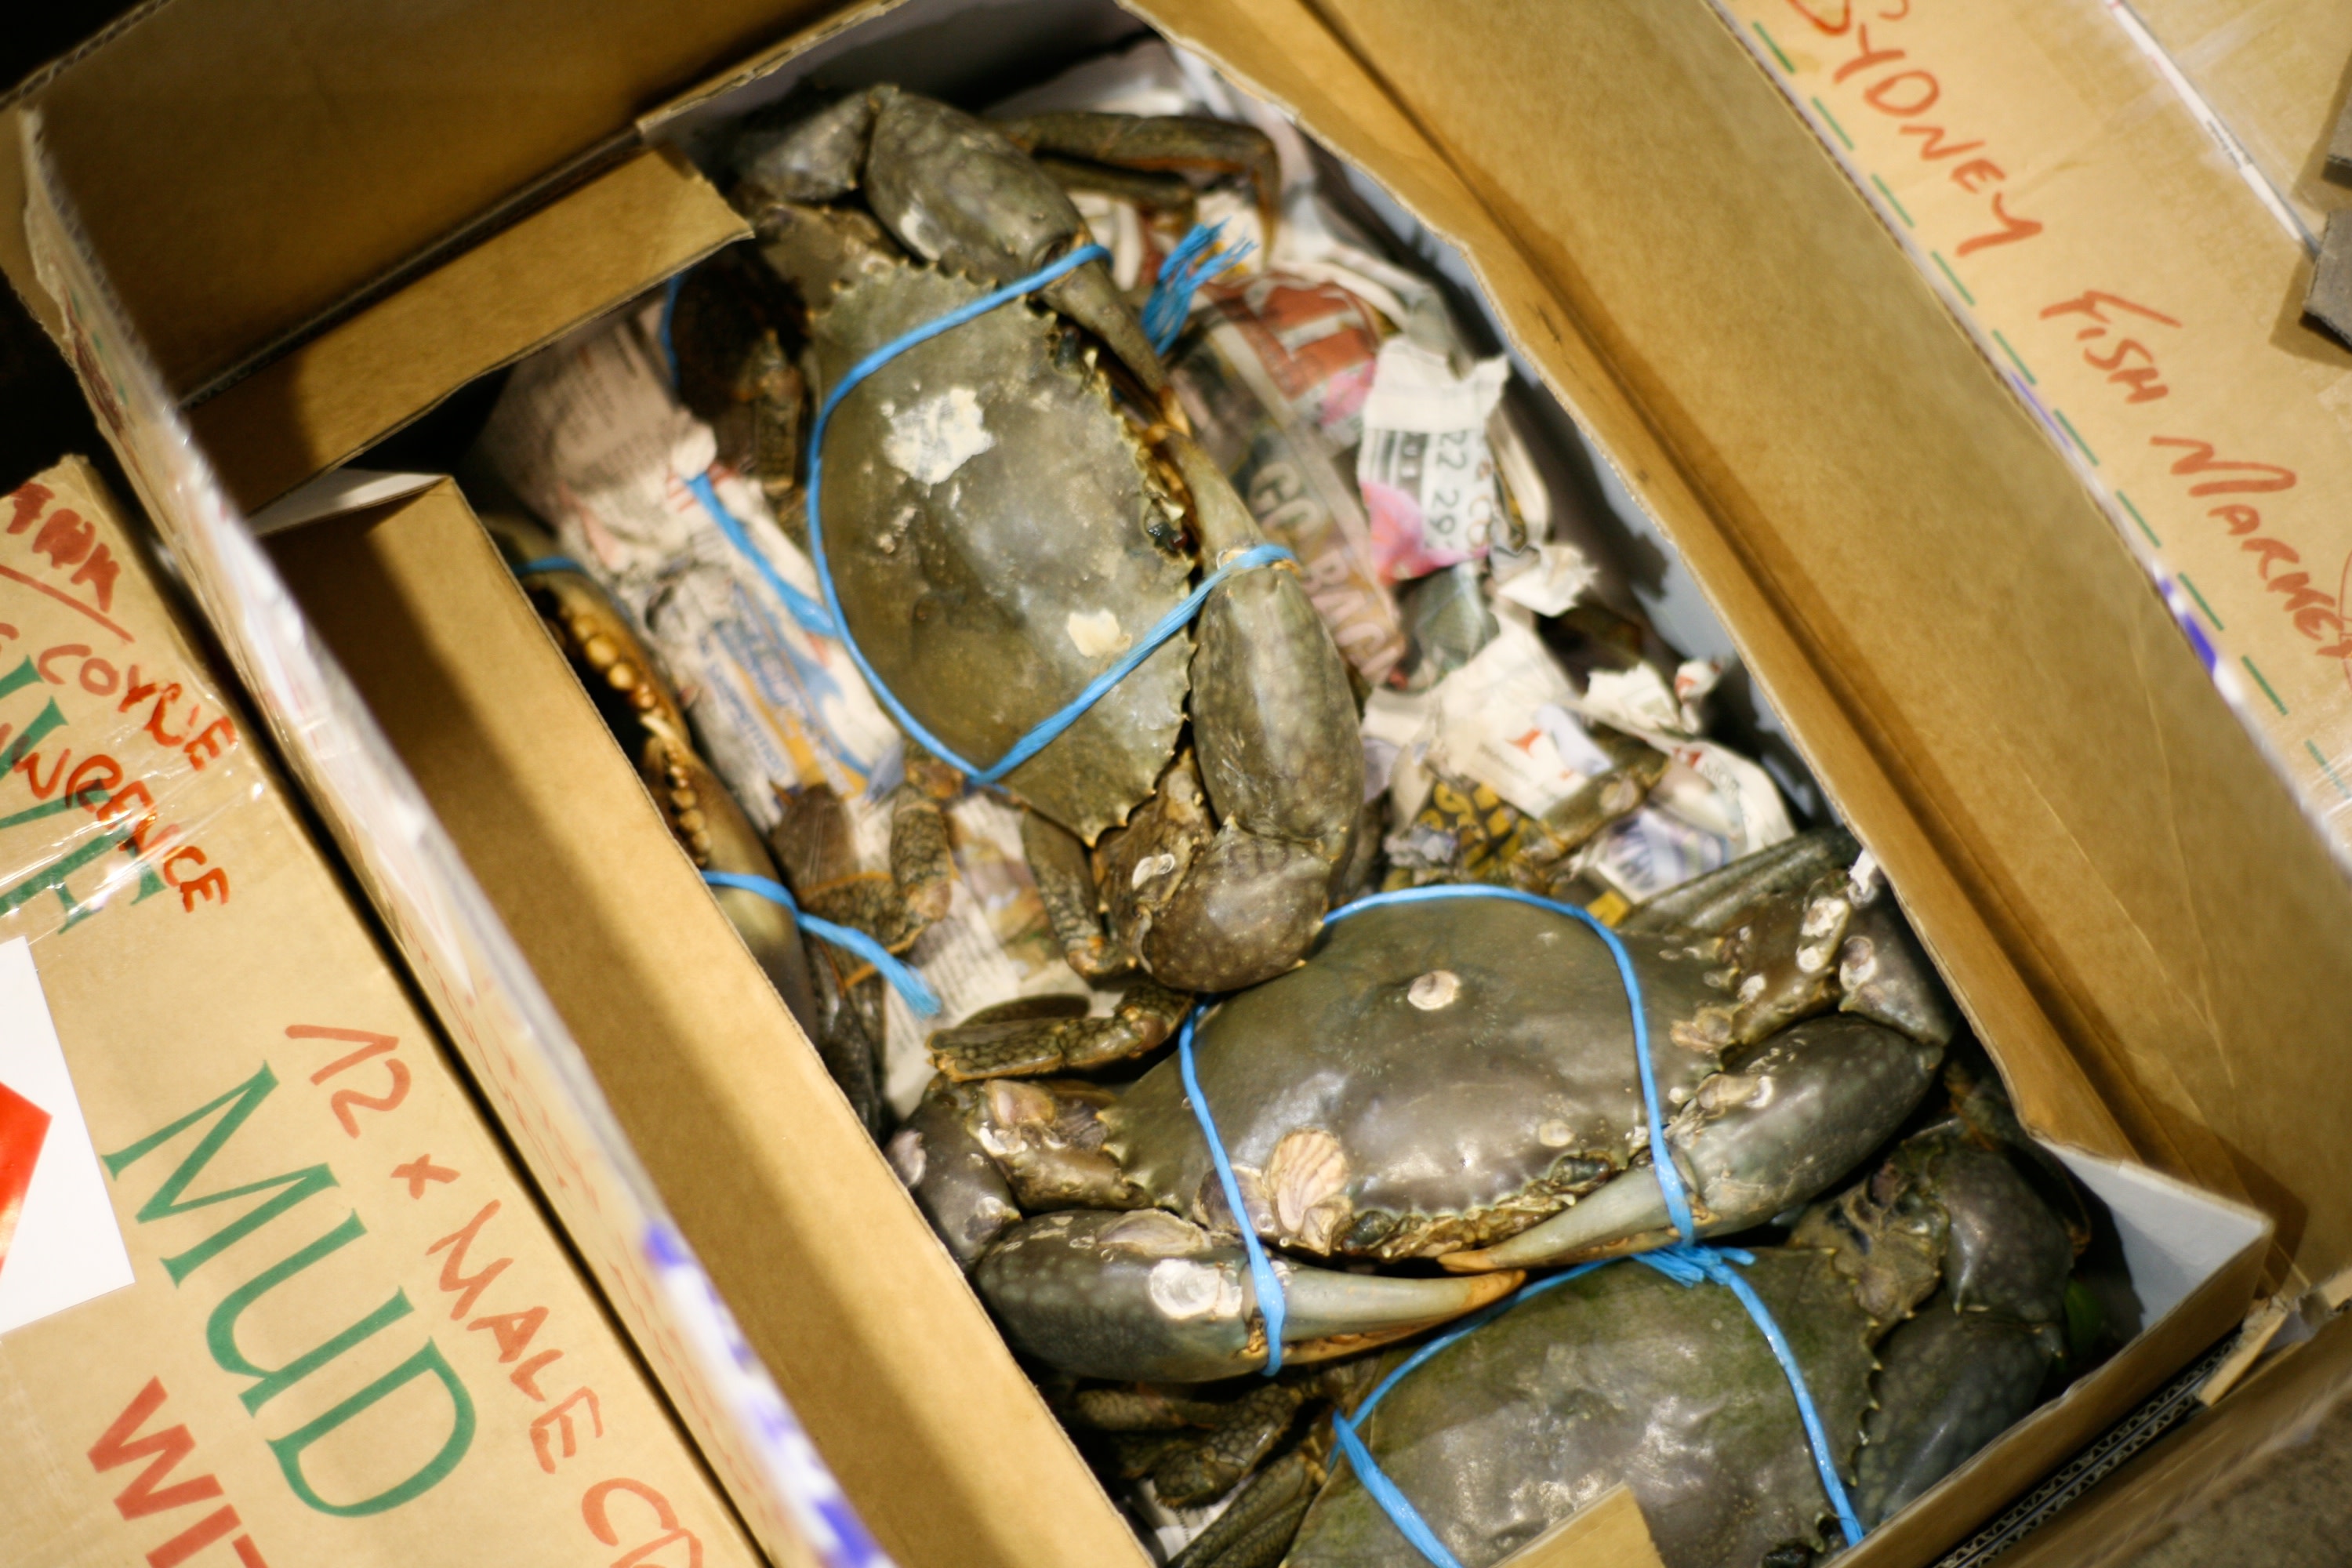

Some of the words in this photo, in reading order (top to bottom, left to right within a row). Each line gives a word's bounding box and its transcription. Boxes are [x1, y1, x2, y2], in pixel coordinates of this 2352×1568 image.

[2038, 289, 2183, 404] FISH
[0, 721, 230, 913] WRENCE
[101, 1060, 477, 1519] MUD
[426, 1199, 604, 1474] MALE
